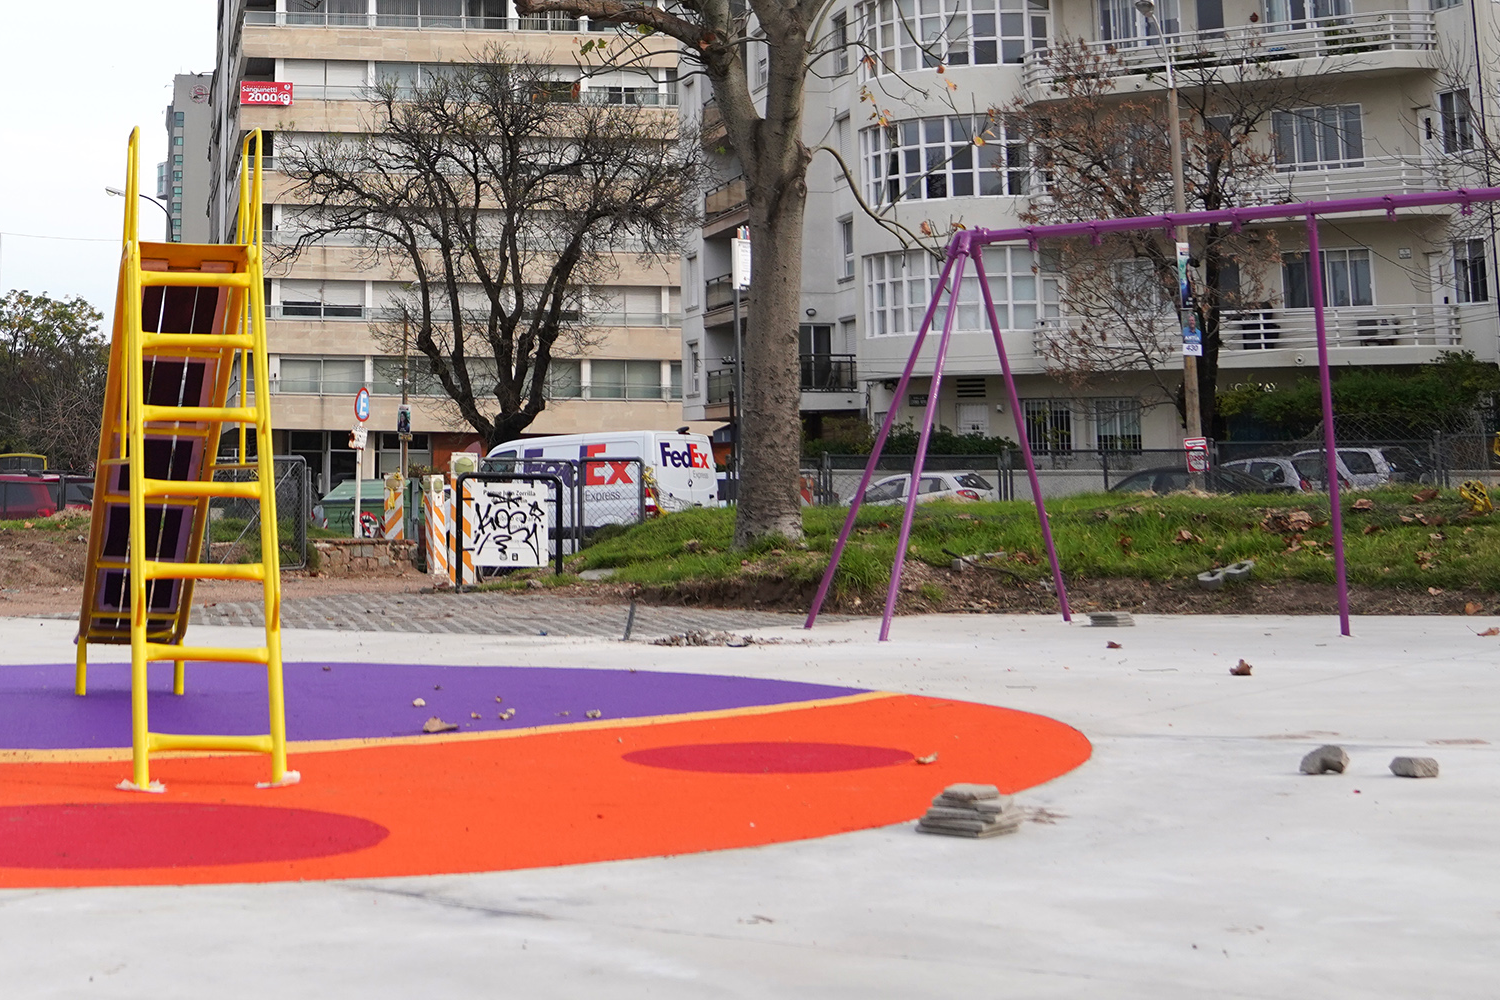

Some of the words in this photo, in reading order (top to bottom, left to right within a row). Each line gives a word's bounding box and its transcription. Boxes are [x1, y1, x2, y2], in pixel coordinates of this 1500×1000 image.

[360, 393, 367, 416] E
[660, 442, 710, 469] FedEx
[585, 490, 621, 502] Express
